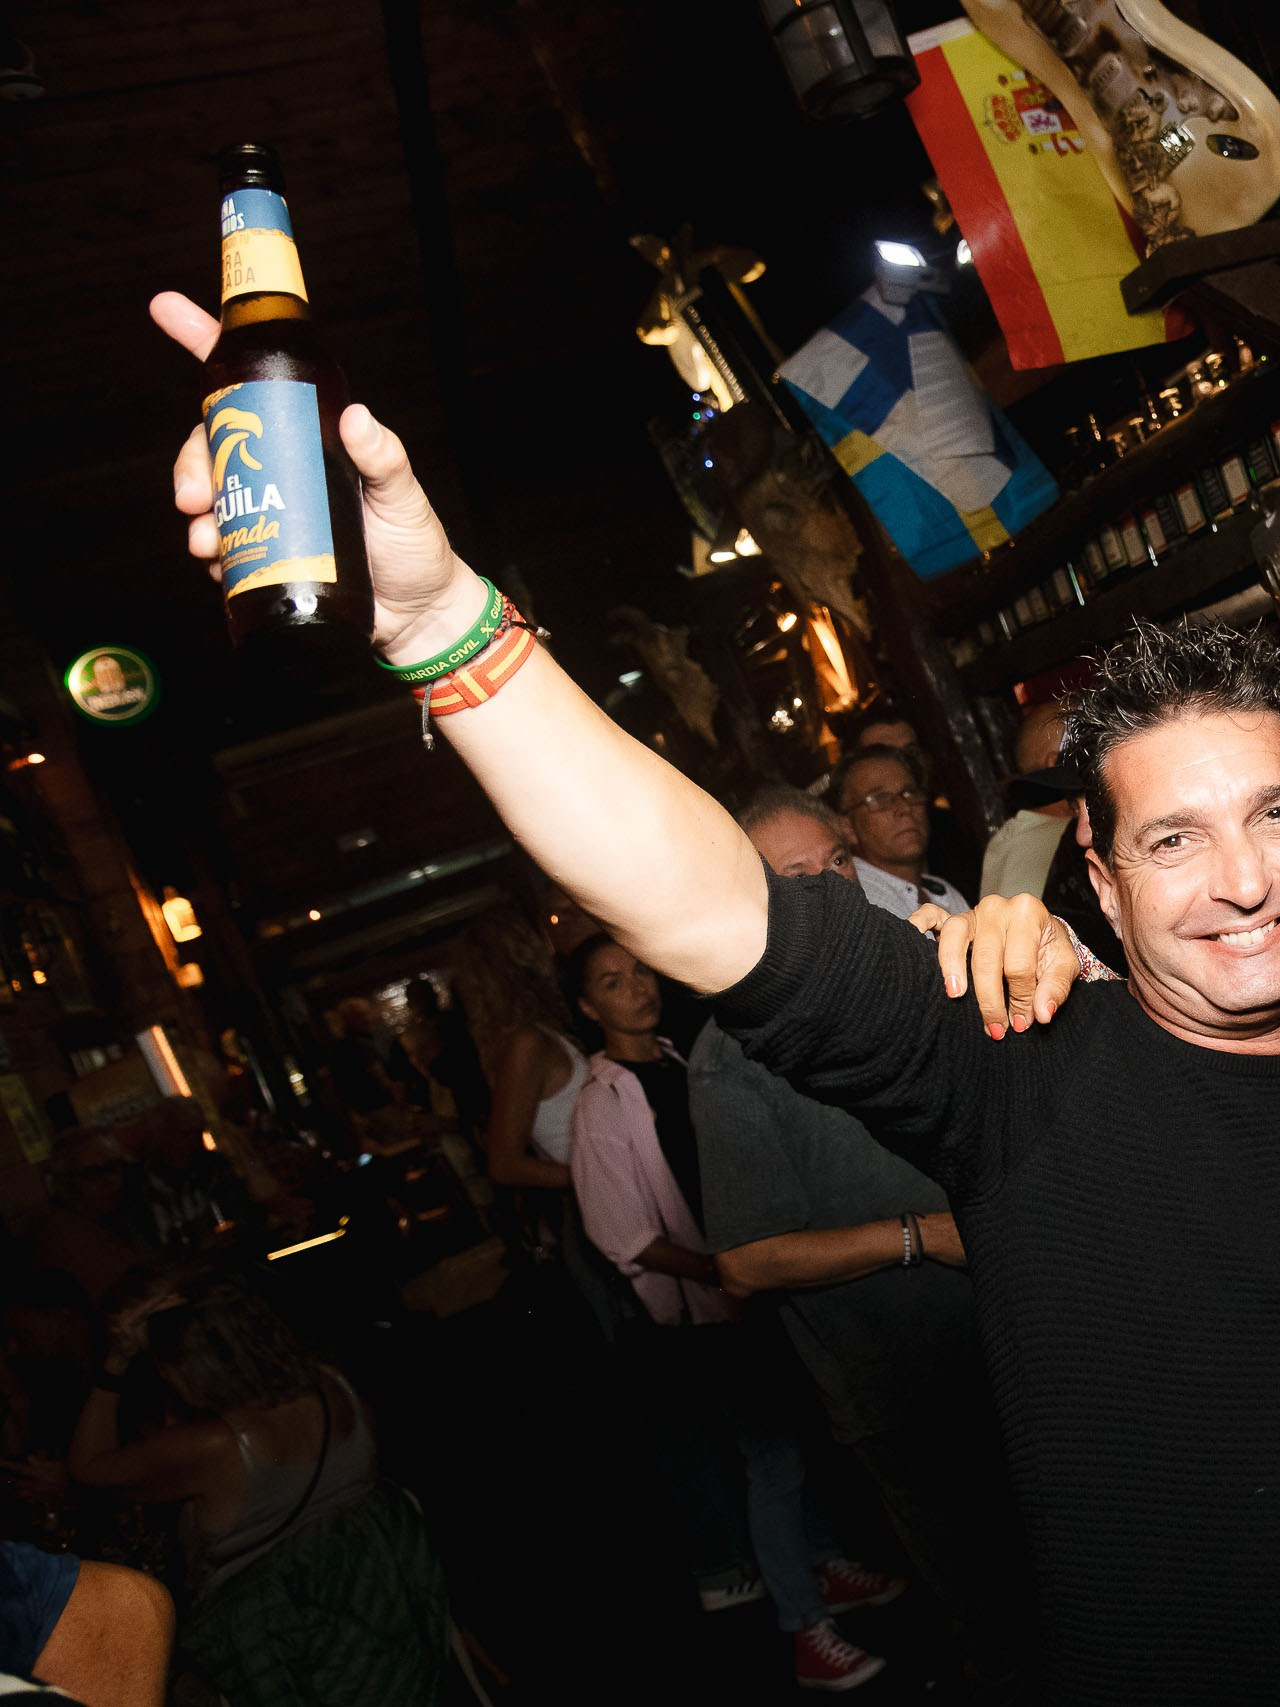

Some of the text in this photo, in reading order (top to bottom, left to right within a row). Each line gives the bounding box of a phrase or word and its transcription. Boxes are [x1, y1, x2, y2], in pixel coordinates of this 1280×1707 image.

[223, 266, 256, 290] ADA
[227, 474, 242, 491] EL
[214, 483, 286, 528] GUILA
[220, 515, 280, 556] orada
[448, 637, 480, 663] CIVIL
